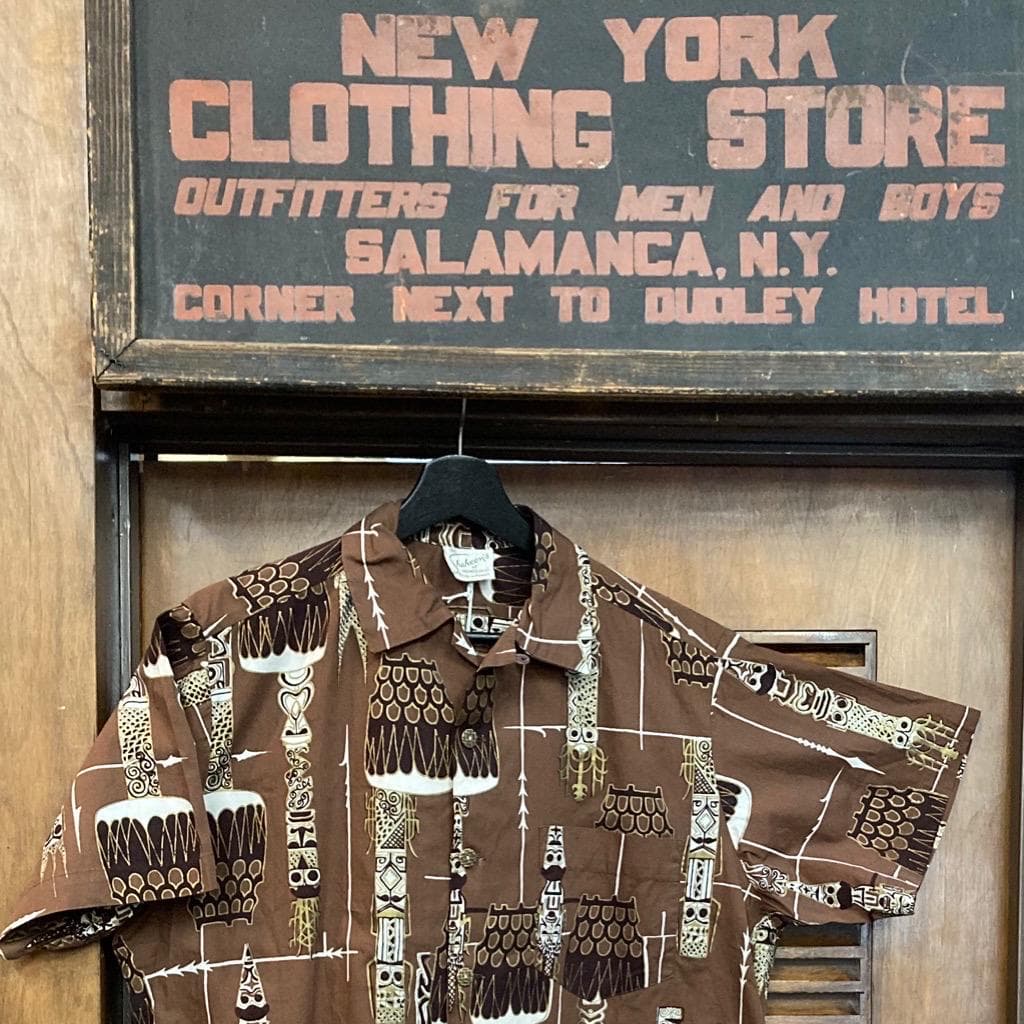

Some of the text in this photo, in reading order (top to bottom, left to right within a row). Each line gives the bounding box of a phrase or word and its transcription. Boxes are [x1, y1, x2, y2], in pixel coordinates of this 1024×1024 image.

[340, 14, 837, 83] NEW YORK
[168, 79, 1006, 170] CLOTHING STORE
[173, 177, 1005, 222] OUTFITTERS FOR MEN AND BOYS
[344, 228, 838, 281] SALAMANCA, N.Y.
[172, 285, 1005, 325] CORNER NEXT TO DUDLEY HOTEL
